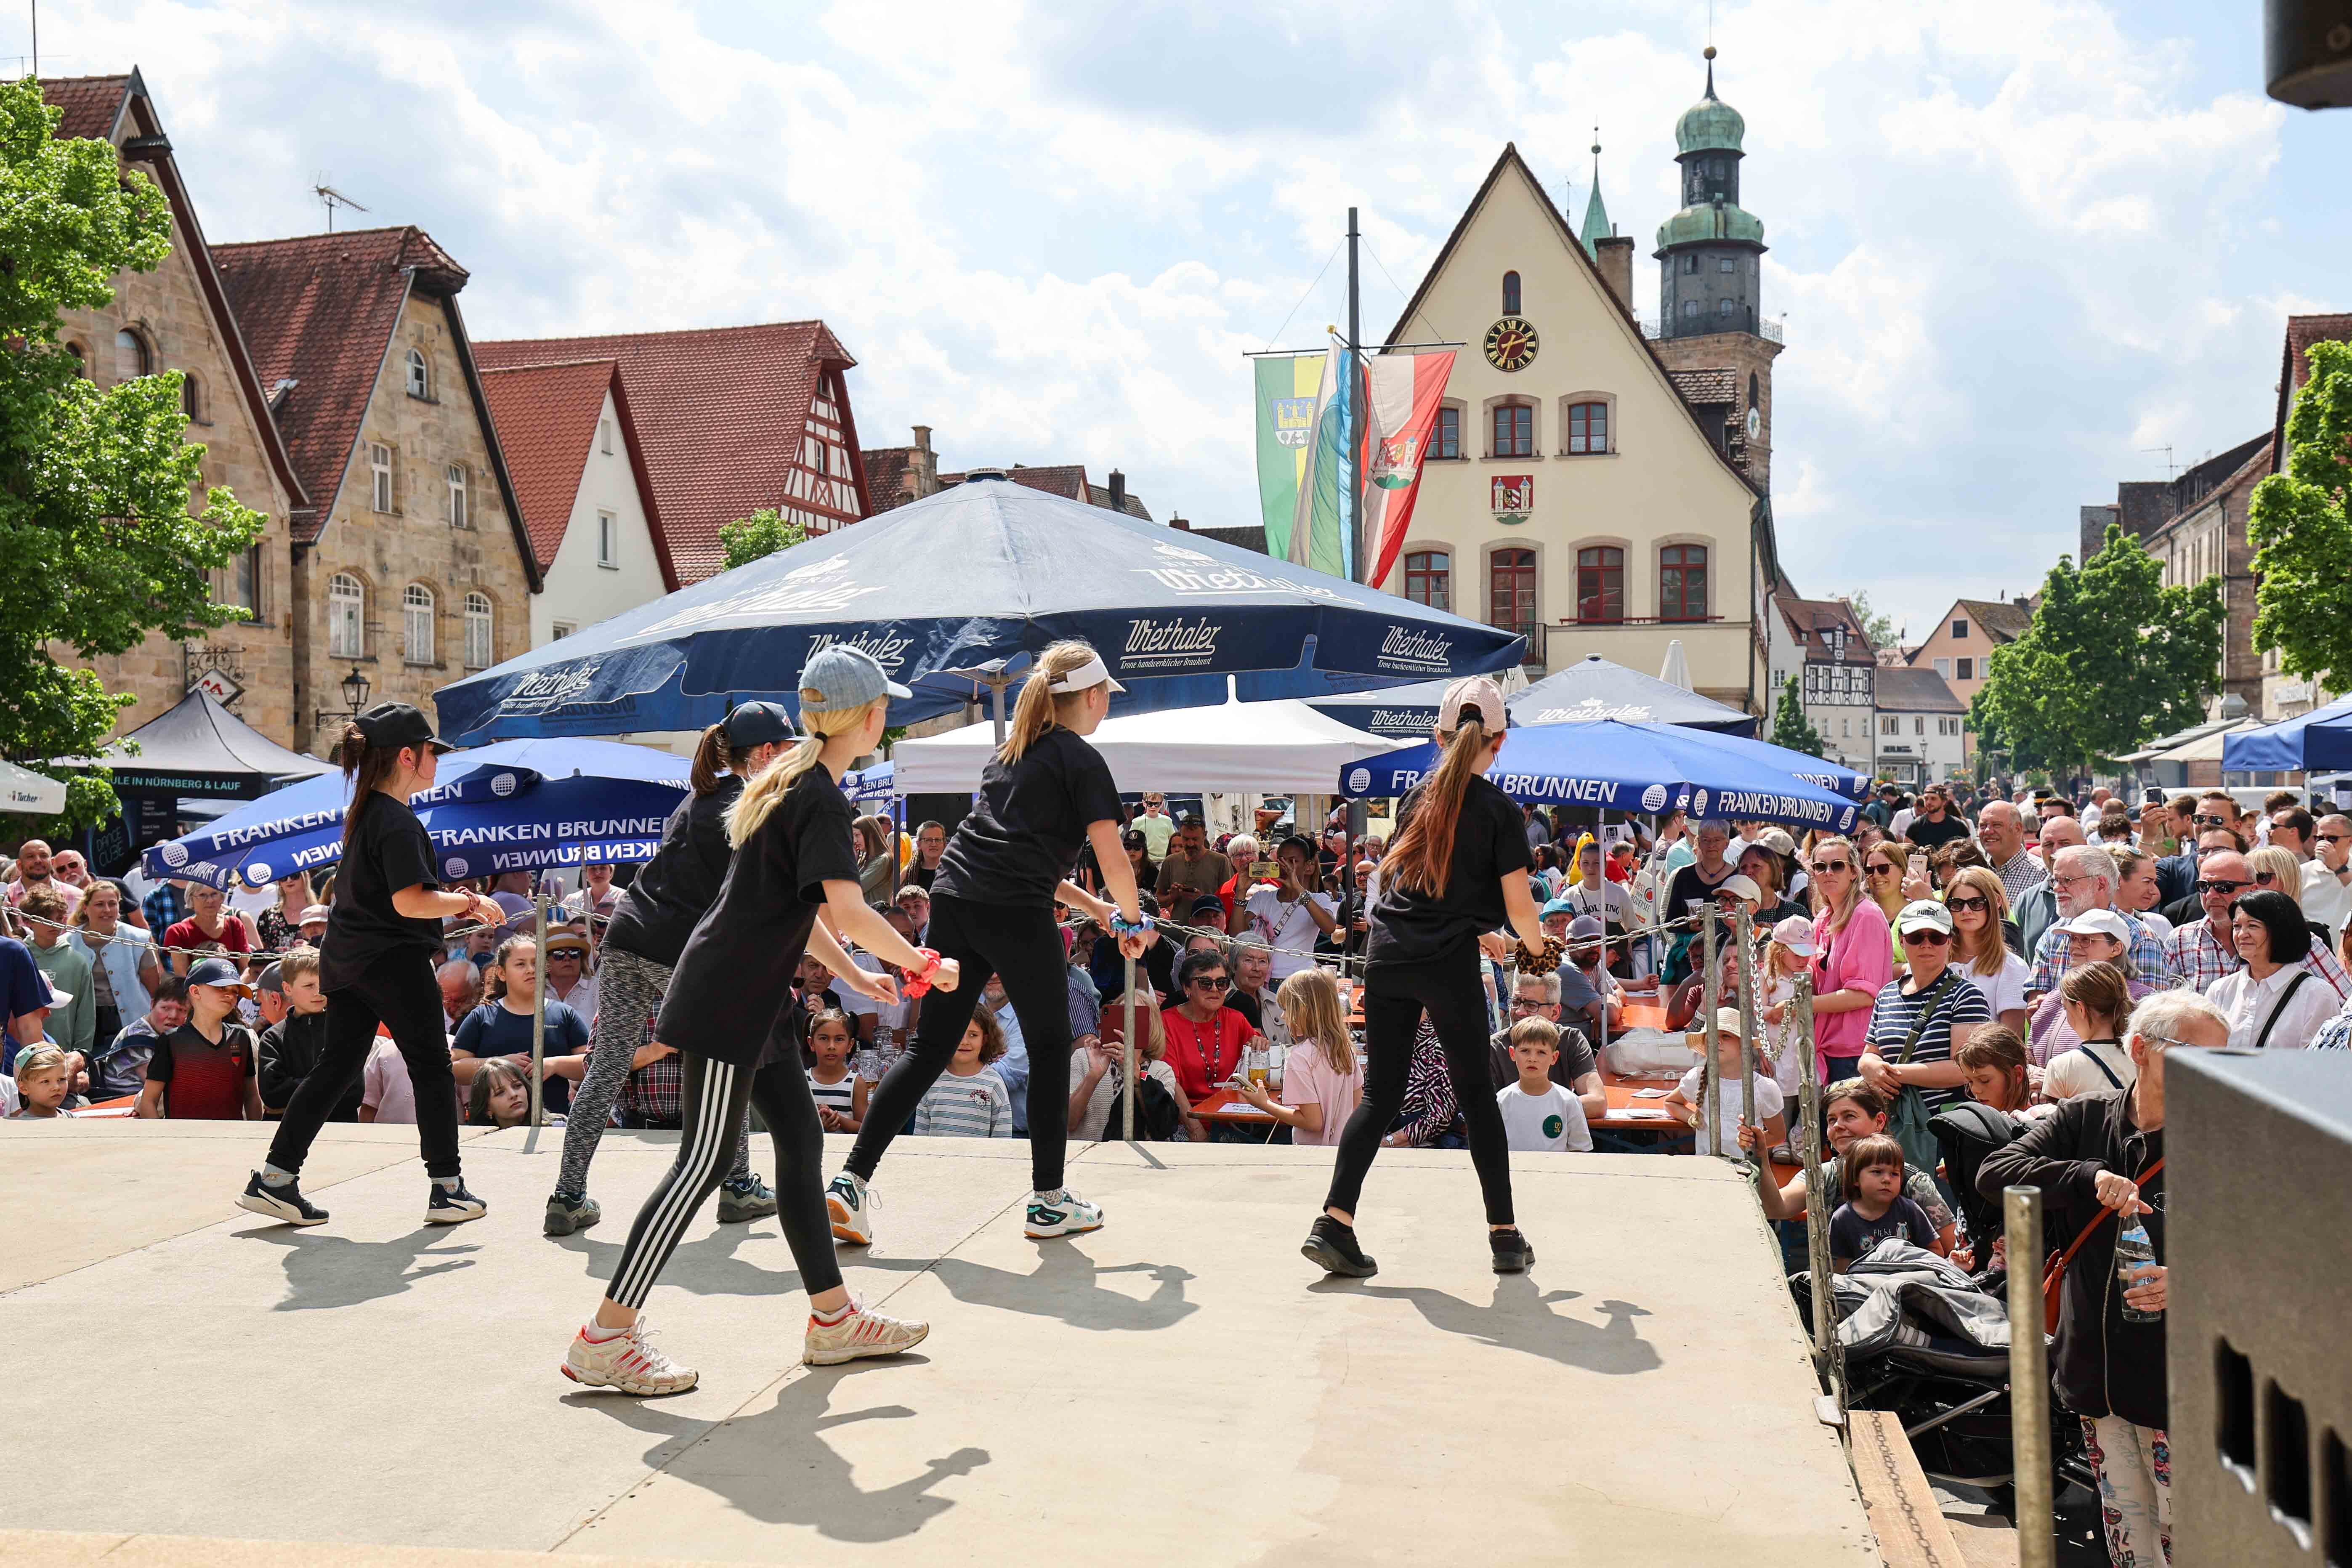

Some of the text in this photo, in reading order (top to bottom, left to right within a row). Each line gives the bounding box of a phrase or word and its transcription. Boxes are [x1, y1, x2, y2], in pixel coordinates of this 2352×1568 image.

[1126, 617, 1222, 653] Wiethaler
[1382, 625, 1453, 662] Wiethaler
[1120, 657, 1212, 669] Krone handwerklicher Braukunst
[1378, 660, 1391, 668] Krone
[1391, 661, 1426, 672] handwerklicher
[1371, 710, 1438, 726] Wiethaler
[1537, 704, 1652, 720] Wiethaler
[132, 777, 143, 785] IN
[146, 775, 202, 789] NÜRNBERG
[214, 781, 241, 791] LAUF
[1502, 774, 1620, 803] BRUNNEN
[17, 791, 38, 803] Tucher
[1718, 791, 1833, 823] FRANKEN BRUNNEN
[212, 808, 338, 852] FRANKEN
[428, 823, 550, 847] FRANKEN
[1634, 881, 1645, 892] OBST
[1583, 902, 1619, 916] ROLING
